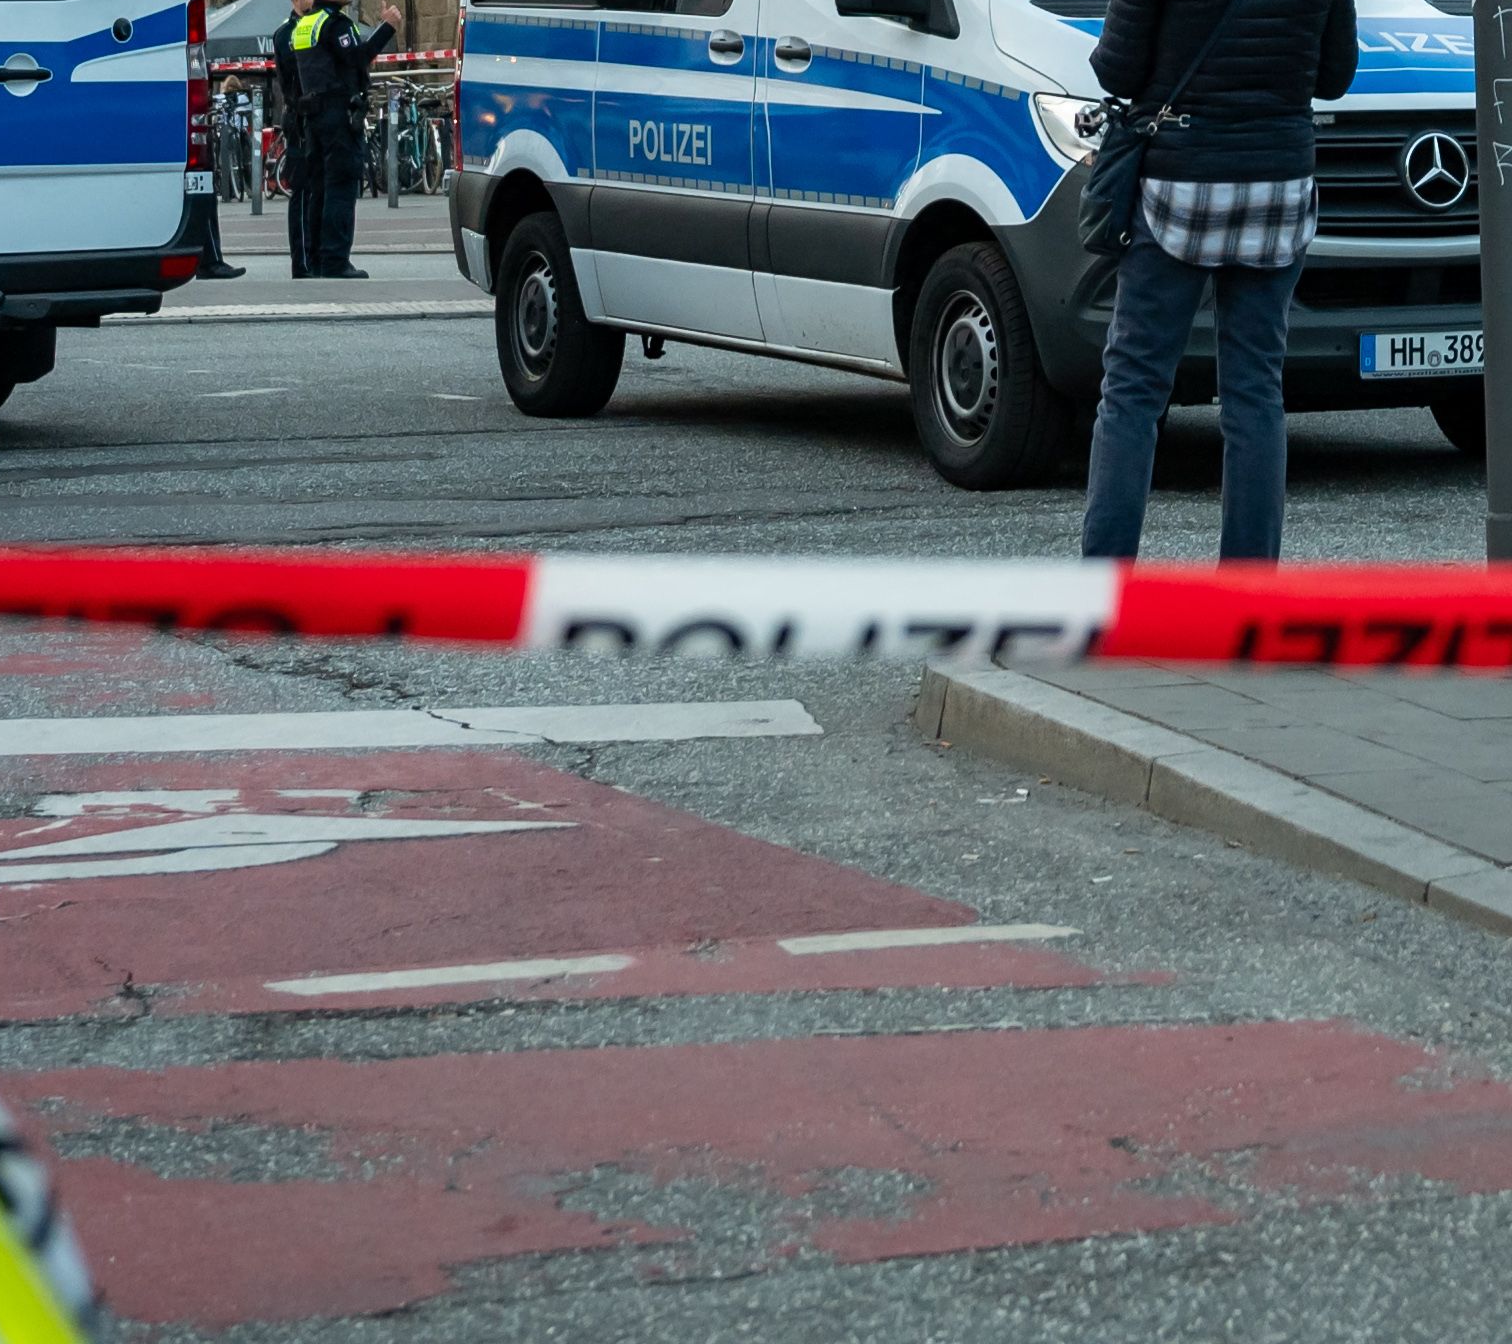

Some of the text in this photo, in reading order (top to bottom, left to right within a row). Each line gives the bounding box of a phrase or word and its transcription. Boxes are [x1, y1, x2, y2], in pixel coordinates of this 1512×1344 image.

[1358, 31, 1475, 56] LIZE
[629, 119, 712, 166] POLIZEI
[1390, 337, 1425, 366] HH
